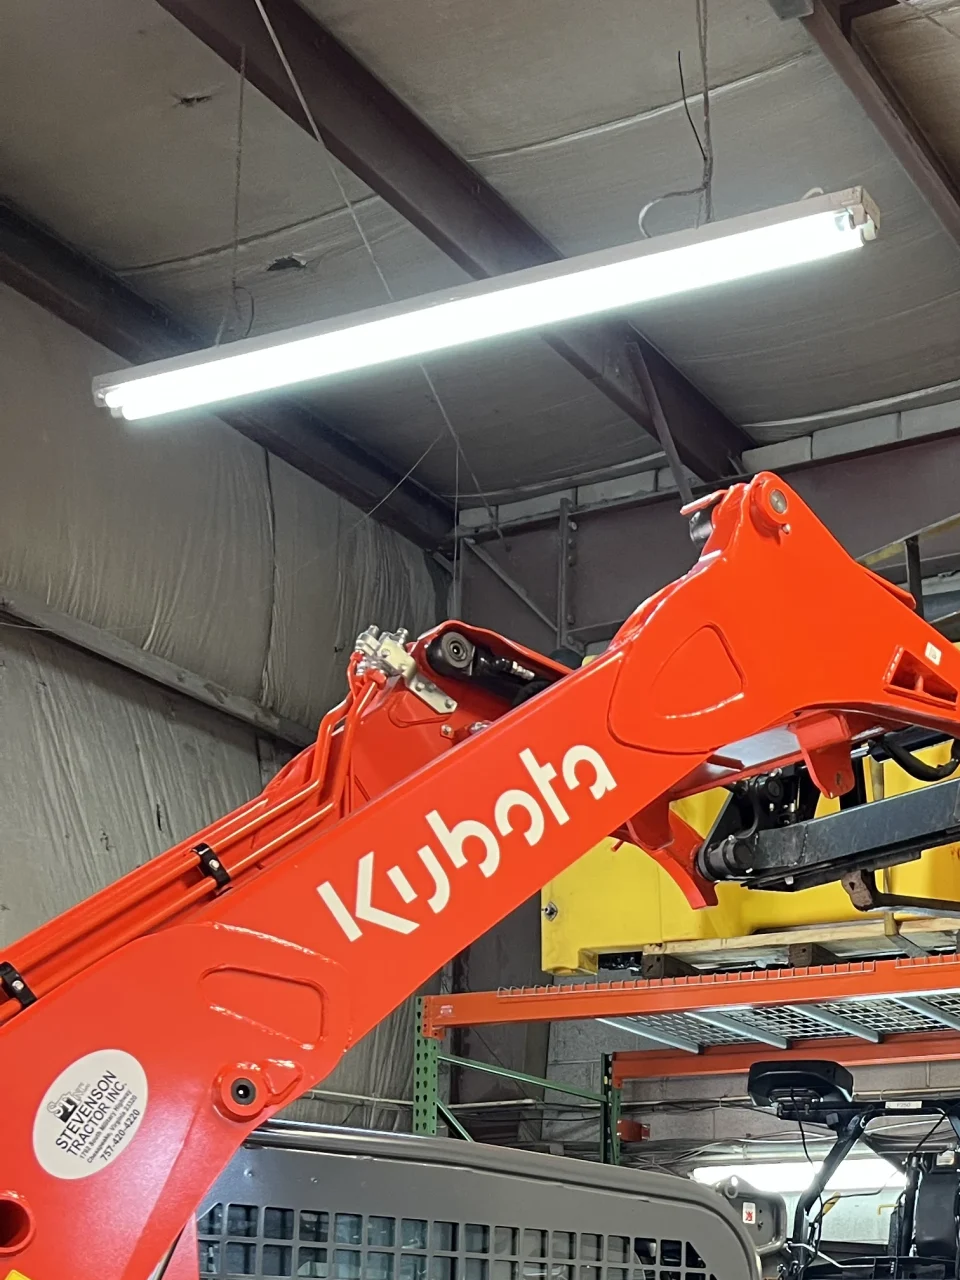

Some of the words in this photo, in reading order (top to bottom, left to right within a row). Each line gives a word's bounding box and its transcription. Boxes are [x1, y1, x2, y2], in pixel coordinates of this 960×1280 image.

[316, 745, 618, 942] Kubota
[55, 1070, 117, 1150] STEVENSON
[66, 1103, 111, 1156] TRACTOR
[105, 1081, 127, 1103] INC.
[90, 1130, 102, 1147] South
[99, 1110, 117, 1131] Military
[114, 1089, 133, 1112] Highway
[100, 1109, 140, 1161] 757-420-4220
[110, 1110, 127, 1131] Virginia
